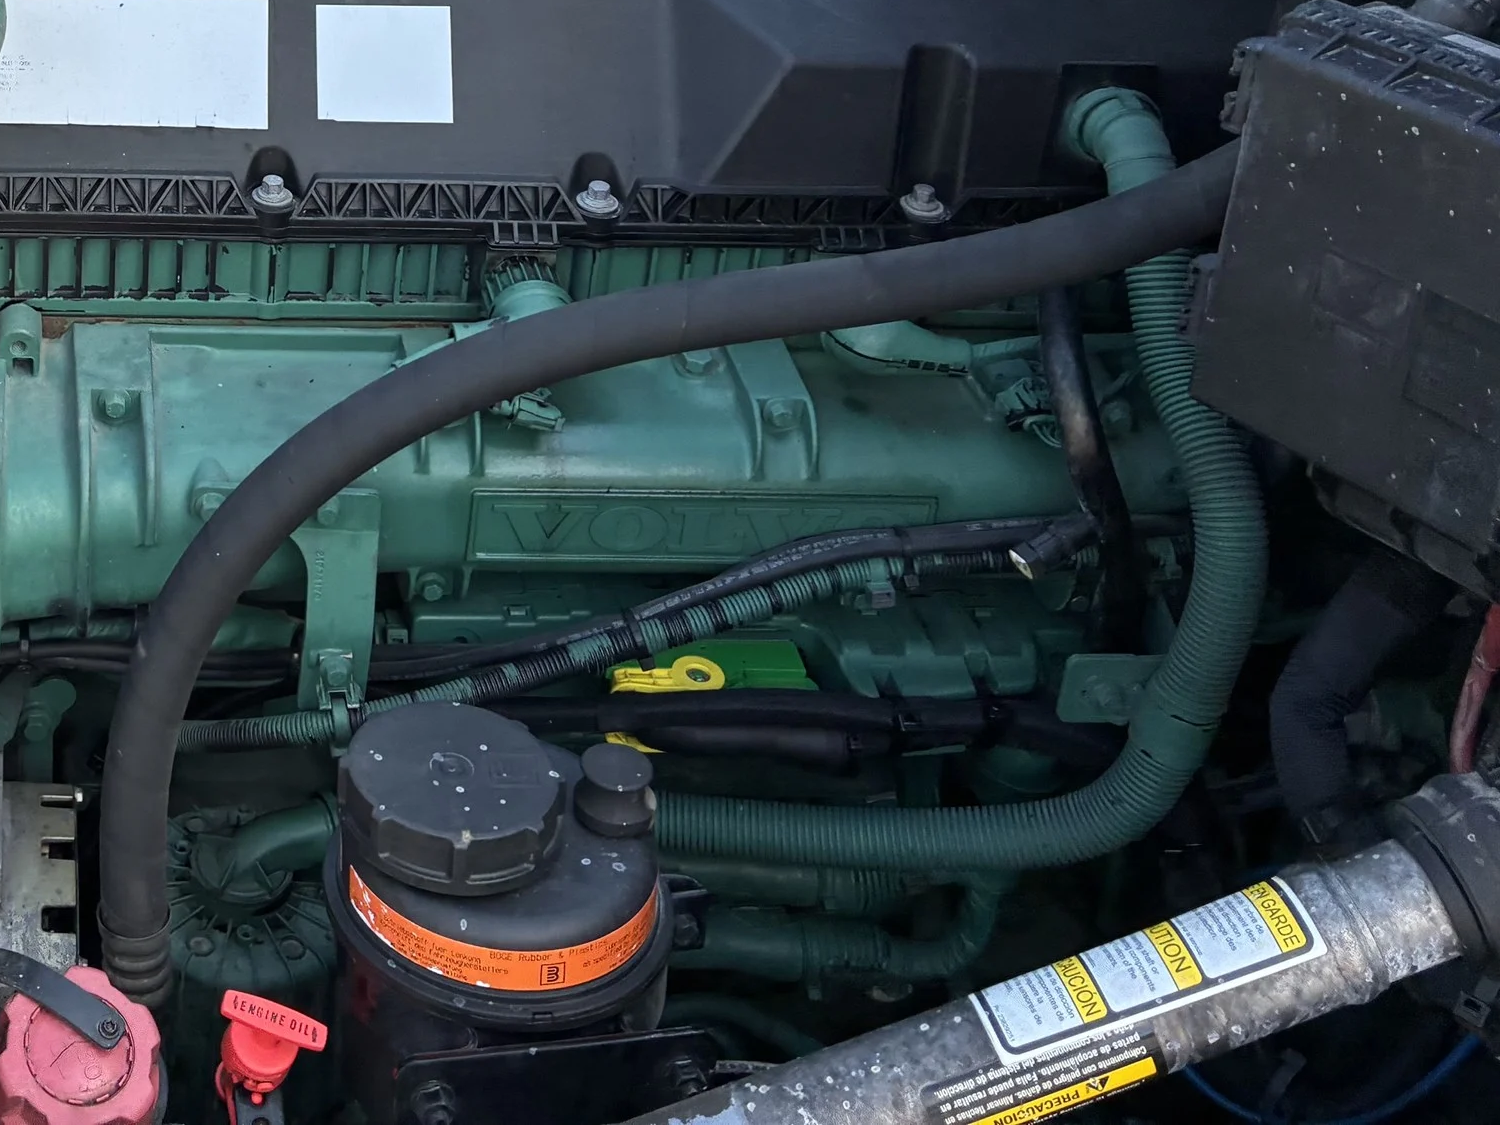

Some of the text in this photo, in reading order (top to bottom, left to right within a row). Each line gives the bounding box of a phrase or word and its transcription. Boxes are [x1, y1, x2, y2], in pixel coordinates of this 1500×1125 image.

[1261, 898, 1301, 948] GARDE
[489, 951, 513, 961] BOGE
[518, 952, 553, 962] Rubber
[568, 939, 608, 957] Plastics
[1149, 925, 1192, 973] UTION
[1141, 947, 1156, 966] shaft
[1151, 966, 1159, 975] or
[1127, 966, 1137, 980] the
[1128, 950, 1156, 992] components
[1056, 957, 1102, 1018] CAUCIÓN
[240, 1000, 309, 1036] ENGINE OIL
[1033, 1013, 1043, 1026] de
[1056, 1010, 1064, 1022] de
[1112, 1031, 1141, 1050] partes
[1097, 1045, 1147, 1069] Componente
[1099, 1046, 1112, 1055] de
[975, 1074, 987, 1085] de
[1015, 1071, 1039, 1086] Falla
[1053, 1067, 1082, 1085] peligro
[1082, 1065, 1098, 1076] con
[988, 1077, 1015, 1093] puede
[1041, 1080, 1053, 1091] de
[940, 1102, 952, 1114] en
[953, 1089, 987, 1109] resultar
[986, 1093, 1014, 1111] Alinear
[955, 1103, 986, 1121] flechas
